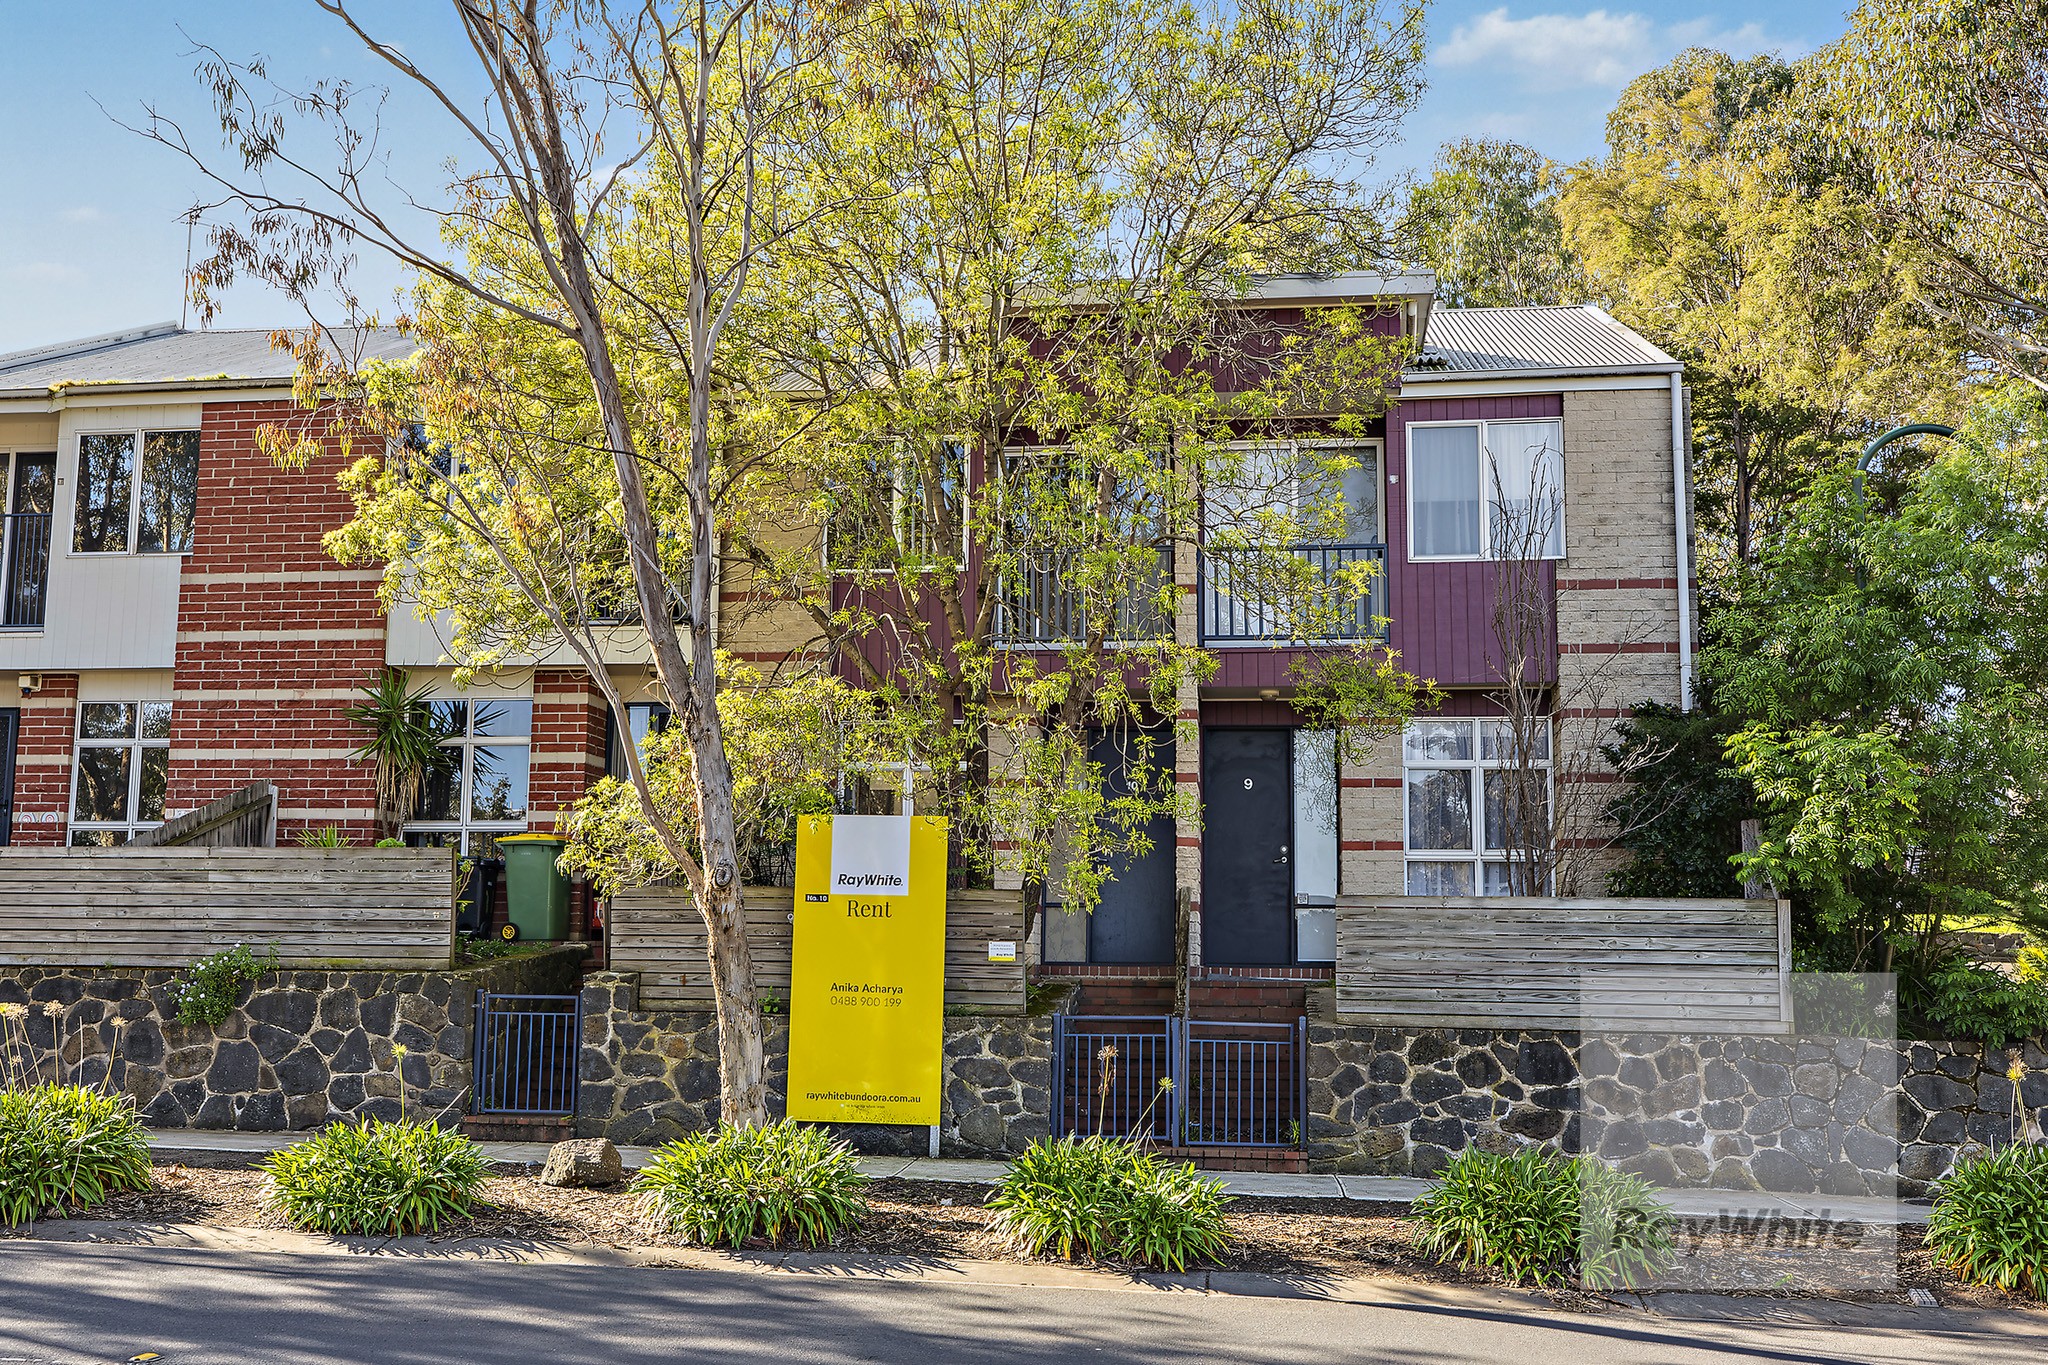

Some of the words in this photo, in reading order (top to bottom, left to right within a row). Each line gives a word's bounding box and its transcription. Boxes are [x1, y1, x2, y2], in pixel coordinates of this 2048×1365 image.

[1126, 781, 1138, 791] 10
[1243, 778, 1254, 790] 9
[819, 894, 828, 902] 10
[847, 899, 893, 918] Rent
[830, 982, 859, 993] Anika
[861, 983, 904, 996] Acharya
[830, 995, 858, 1006] 0488
[860, 996, 881, 1007] 900
[883, 997, 902, 1008] 199
[806, 1091, 921, 1103] raywhitebundoora.com.au
